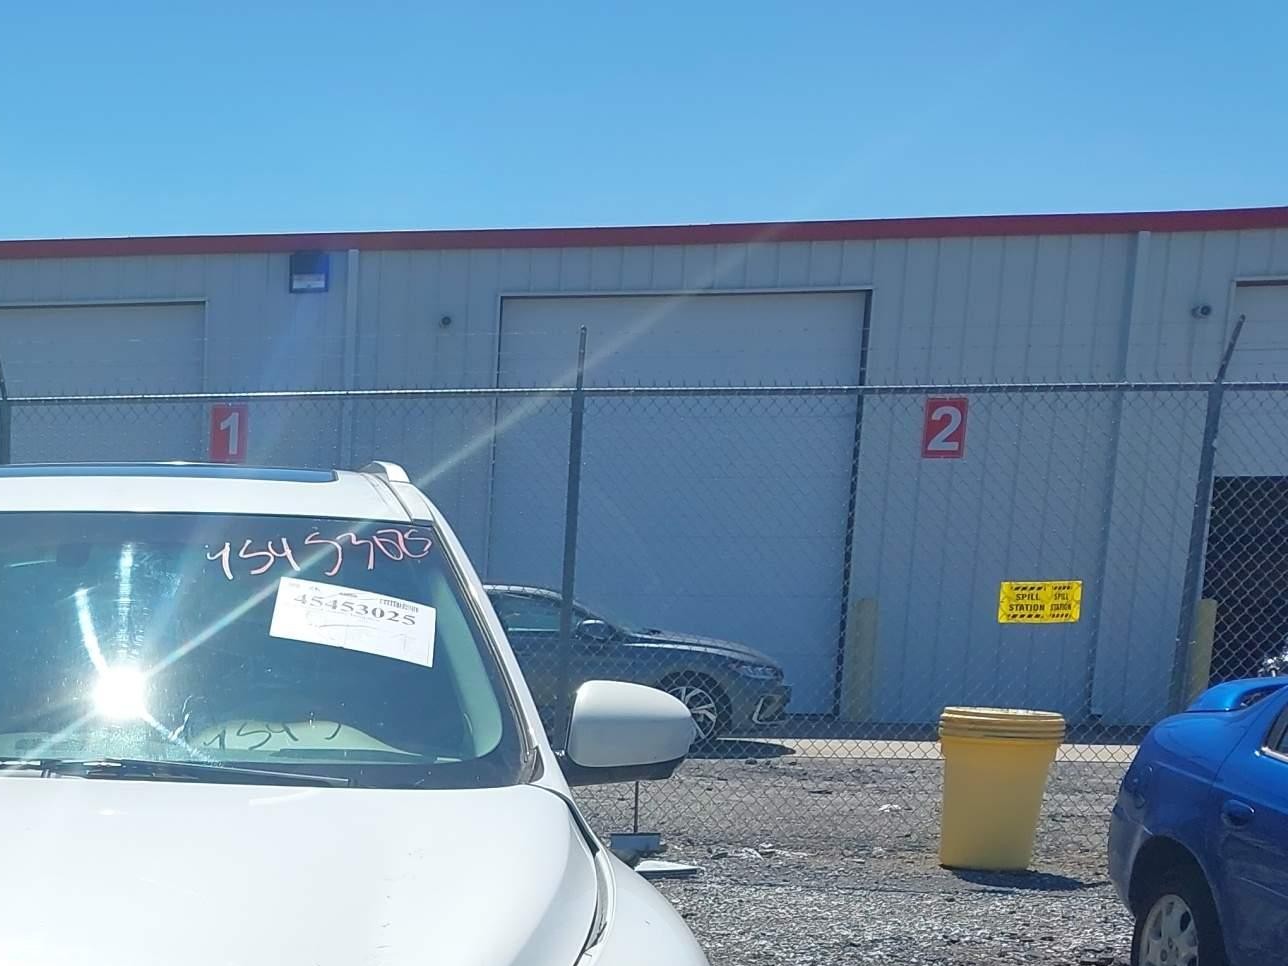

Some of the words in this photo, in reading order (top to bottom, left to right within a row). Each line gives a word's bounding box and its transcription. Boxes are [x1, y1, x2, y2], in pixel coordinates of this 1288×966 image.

[219, 411, 240, 455] 1
[927, 405, 962, 451] 2
[1008, 603, 1045, 612] STATION
[1015, 593, 1040, 601] SPILL
[1054, 593, 1069, 601] SPILL
[293, 593, 417, 627] 45453025
